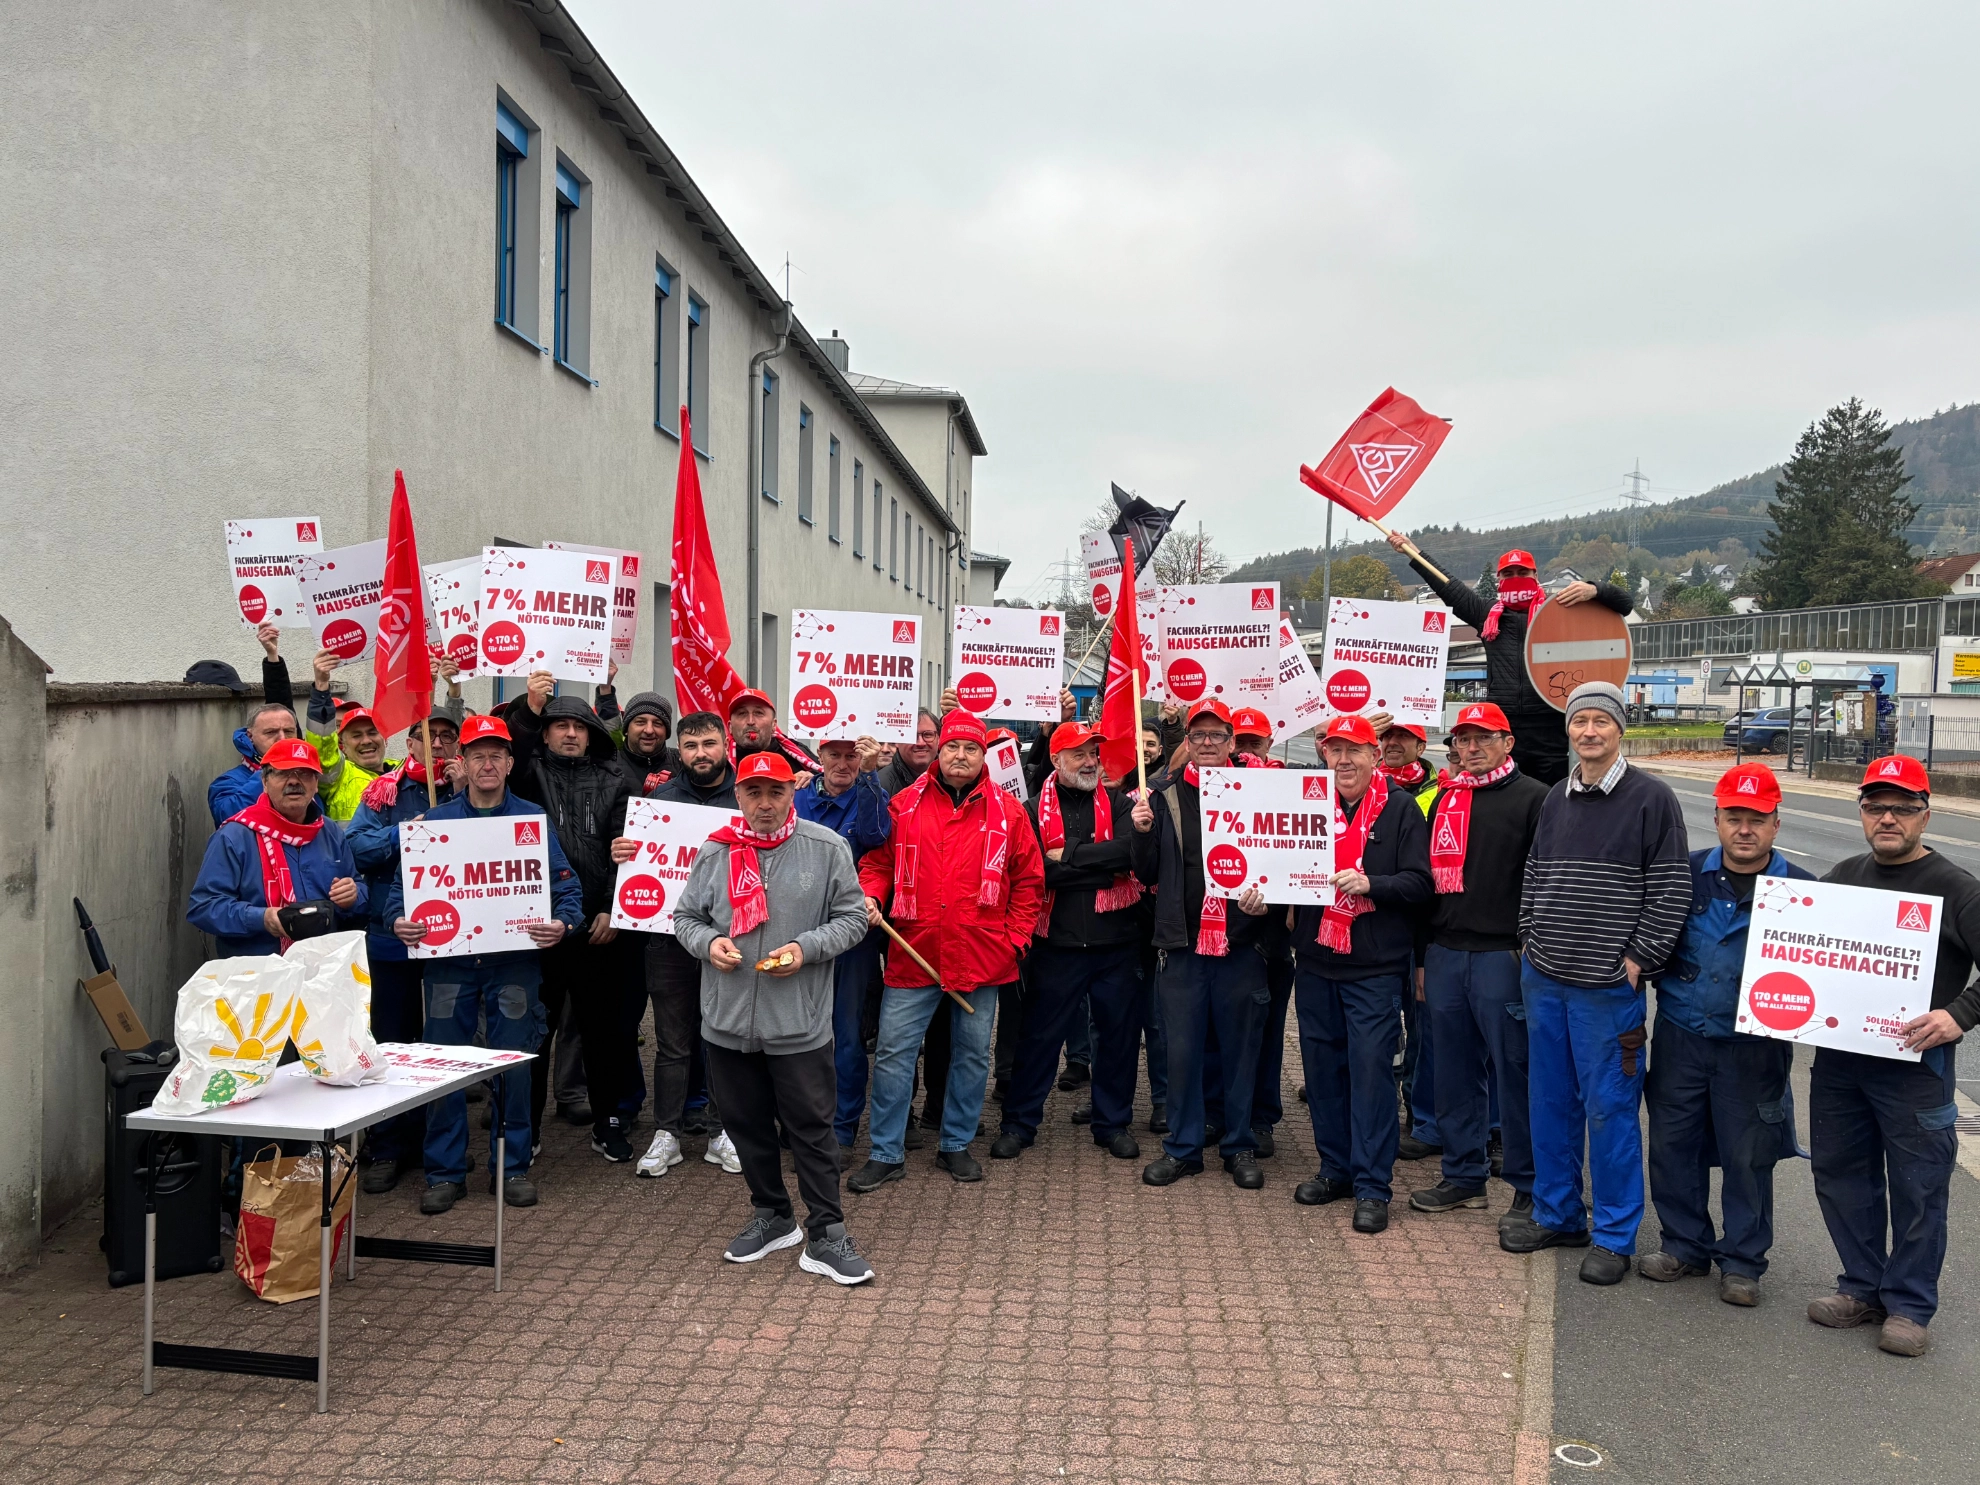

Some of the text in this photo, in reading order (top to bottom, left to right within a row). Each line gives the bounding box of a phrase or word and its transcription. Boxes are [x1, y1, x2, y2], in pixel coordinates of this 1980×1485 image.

[236, 566, 295, 577] HAUSGEMA
[1089, 565, 1122, 579] HAUSGEM
[313, 580, 384, 602] FACHKRÄFTEMA
[613, 587, 635, 607] HR
[316, 591, 383, 615] HAUSGEM
[533, 590, 607, 618] MEHR
[518, 612, 605, 630] NÖTIG UND FAIR!
[617, 609, 634, 619] FAIR!
[1167, 624, 1270, 636] FACHKRÄFTEMANGEL?!
[325, 638, 336, 646] 170
[343, 629, 362, 640] MEHR
[495, 636, 510, 644] 170
[512, 635, 518, 643] €
[1168, 635, 1270, 650] HAUSGEMACHT!
[457, 645, 469, 655] 170
[488, 644, 519, 653] für Azubis
[962, 643, 1055, 655] FACHKRÄFTEMANGEL?!
[1335, 638, 1438, 654] FACHKRÄFTEMANGEL?!
[566, 650, 603, 659] SOLIDARITÄT
[961, 653, 1055, 668] HAUSGEMACHT!
[1334, 648, 1438, 669] HAUSGEMACHT!
[844, 653, 914, 678] MEHR
[680, 657, 716, 702] BAYERN
[829, 676, 912, 691] NÖTIG UND FAIR!
[807, 699, 822, 707] 170
[825, 698, 830, 707] €
[1403, 696, 1437, 704] SOLIDARITÄT
[1253, 812, 1328, 836] MEHR
[1238, 836, 1326, 850] NÖTIG UND FAIR!
[1219, 859, 1233, 867] 170
[1235, 859, 1240, 867] €
[464, 859, 542, 886] MEHR
[448, 884, 542, 900] NÖTIG UND FAIR!
[634, 889, 649, 898] 170
[652, 890, 658, 898] €
[625, 898, 635, 906] für
[425, 915, 442, 925] 170
[445, 913, 452, 922] €
[505, 917, 544, 926] SOLIDARITÄT
[430, 923, 454, 933] Azubis
[1763, 928, 1921, 961] FACHKRÄFTEMANGEL?!
[1761, 943, 1919, 981] HAUSGEMACHT!
[1754, 992, 1810, 1005] 170 € MEHR
[1756, 1001, 1769, 1009] FÜR
[1785, 1004, 1807, 1012] AZUBIS
[1866, 1016, 1908, 1028] SOLIDARI
